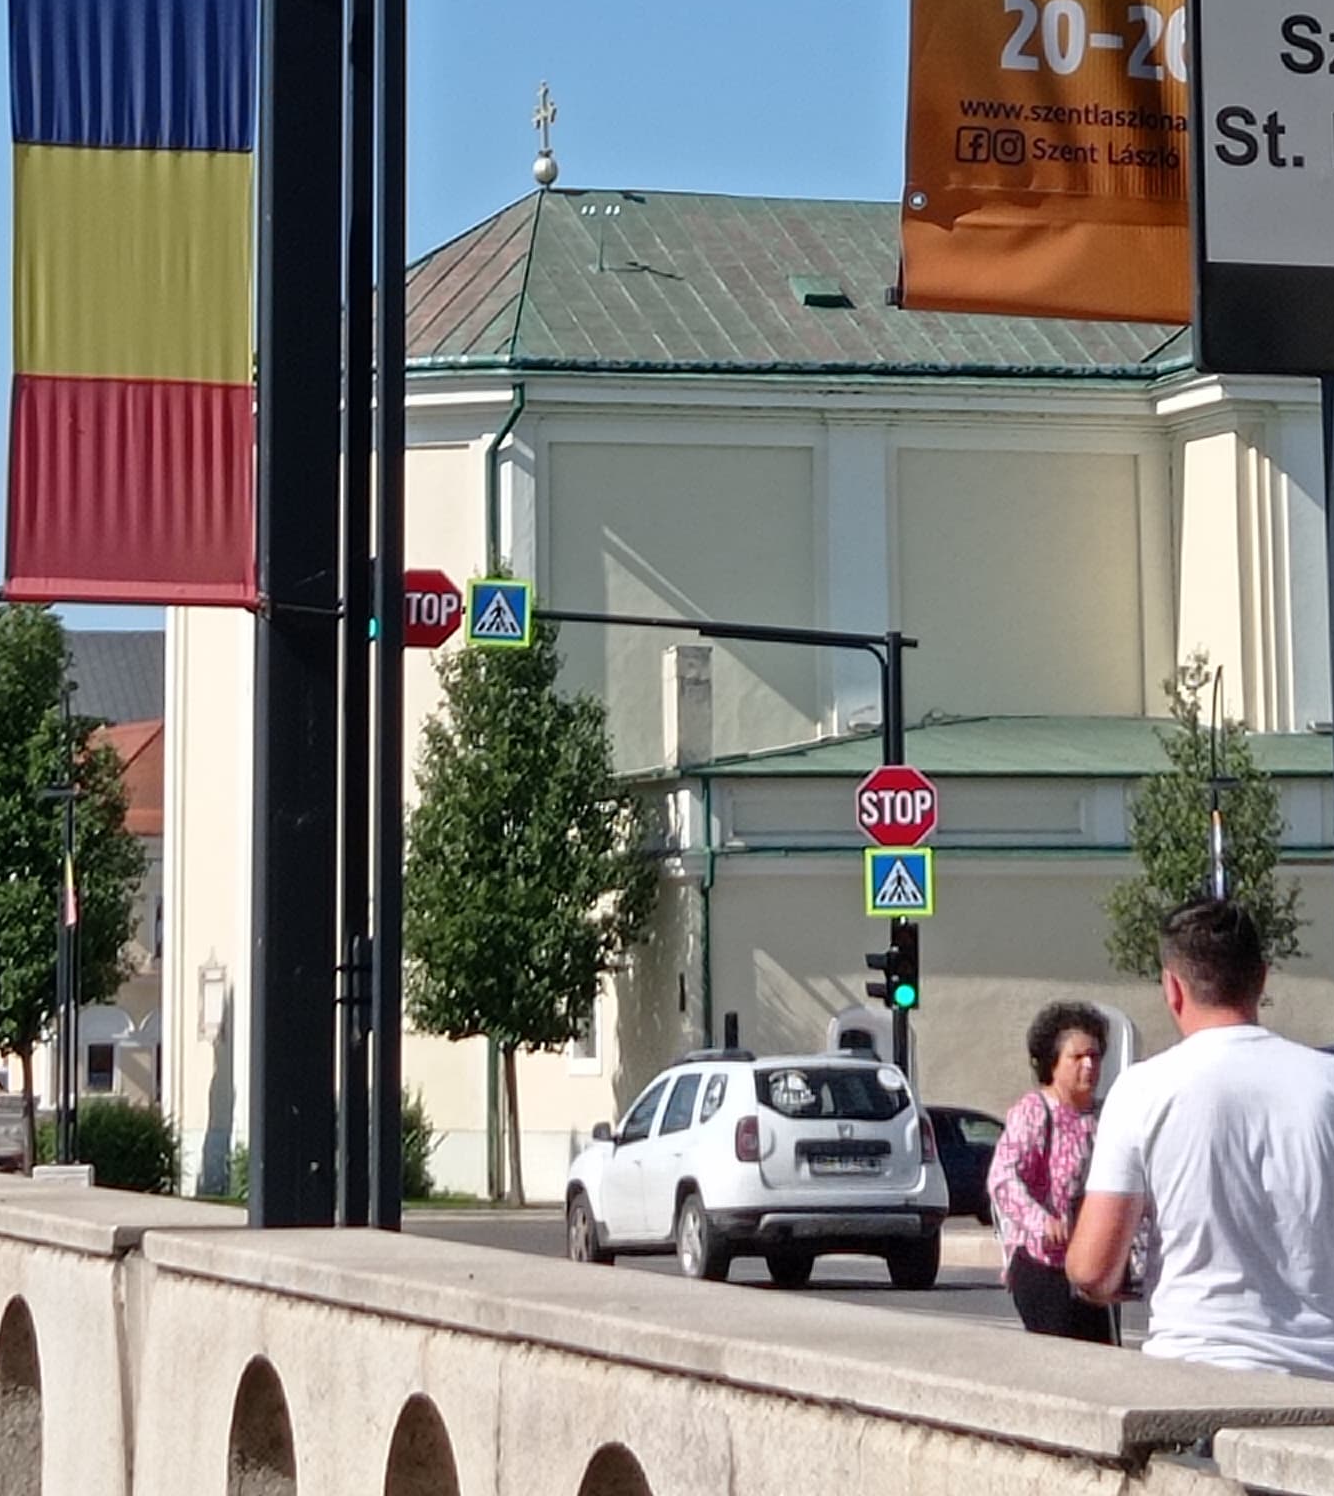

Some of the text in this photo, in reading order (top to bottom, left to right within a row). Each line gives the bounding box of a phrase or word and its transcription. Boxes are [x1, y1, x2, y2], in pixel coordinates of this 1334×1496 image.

[1031, 137, 1181, 171] Szent László
[1214, 105, 1306, 169] St.
[405, 593, 459, 626] TOP
[860, 789, 933, 826] STOP
